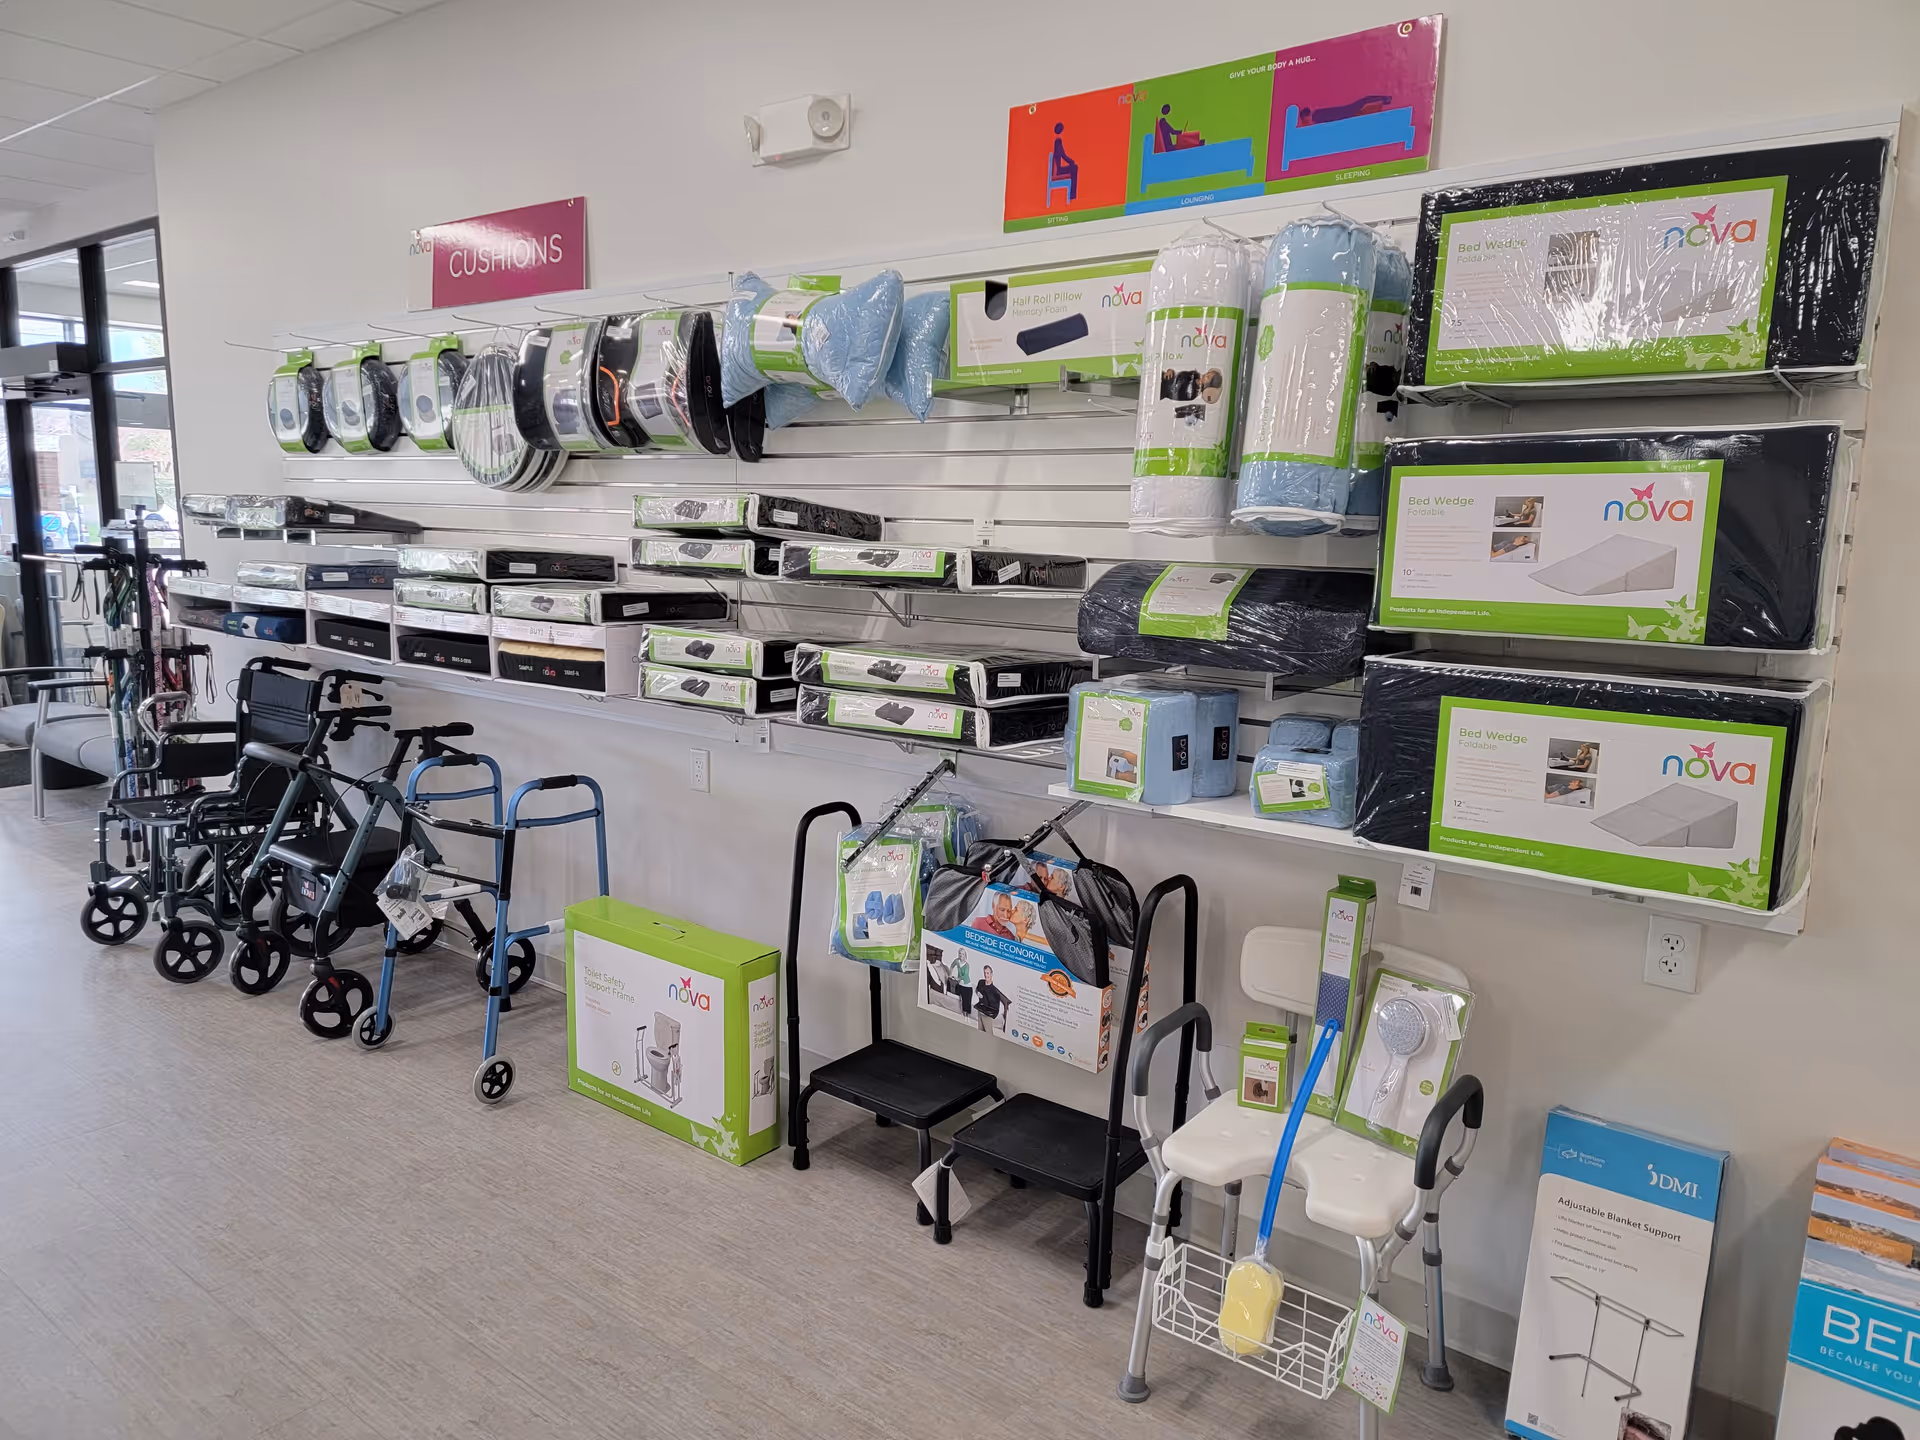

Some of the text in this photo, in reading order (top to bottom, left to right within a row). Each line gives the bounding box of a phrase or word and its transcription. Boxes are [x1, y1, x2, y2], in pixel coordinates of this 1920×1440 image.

[1229, 69, 1245, 80] GIVE
[1246, 65, 1266, 76] YOUR
[1267, 61, 1287, 72] BODY
[1288, 59, 1294, 67] A
[1117, 90, 1147, 106] nova
[1335, 168, 1371, 181] SLEEPING
[1180, 193, 1215, 205] LOUNGING
[1047, 215, 1069, 224] SITTING
[1663, 219, 1757, 249] nova
[409, 239, 432, 256] nova
[1458, 241, 1481, 254] Bed
[449, 233, 563, 278] CUSHIONS
[1456, 253, 1497, 265] Foldable
[1012, 292, 1083, 307] Half Roll Pillow
[1101, 290, 1142, 308] nova
[1012, 304, 1068, 317] Memory Foam
[1181, 335, 1227, 348] nova
[1408, 496, 1475, 507] Bed Wedge
[1407, 508, 1445, 516] Foldable
[1602, 497, 1694, 523] nova
[1436, 608, 1477, 616] Independent
[725, 645, 741, 654] nova
[919, 668, 939, 676] nova
[720, 684, 736, 692] nova
[927, 711, 948, 720] nova
[1127, 709, 1142, 718] nova
[1459, 728, 1528, 744] Bed Wedge
[1179, 738, 1187, 766] nova
[1458, 740, 1498, 751] Foldable
[1661, 754, 1756, 785] nova
[918, 820, 939, 829] nova
[1439, 835, 1468, 845] Products
[1488, 843, 1530, 855] Independent
[1530, 849, 1545, 857] Life.
[880, 852, 904, 863] nova
[1331, 911, 1354, 922] nova
[965, 930, 998, 948] BEDSIDE
[999, 941, 1048, 964] ECONORAIL
[583, 965, 626, 991] Toilet Safety
[583, 976, 635, 1004] Support Frame
[668, 983, 710, 1012] nova
[753, 997, 775, 1013] nova
[577, 1077, 597, 1092] Products
[597, 1087, 605, 1095] for
[611, 1094, 642, 1112] Independent
[641, 1107, 652, 1117] Life
[1557, 1196, 1682, 1242] Adjustable Blanket Support
[1364, 1312, 1399, 1344] nova
[1819, 1345, 1914, 1384] BECAUSE YOU
